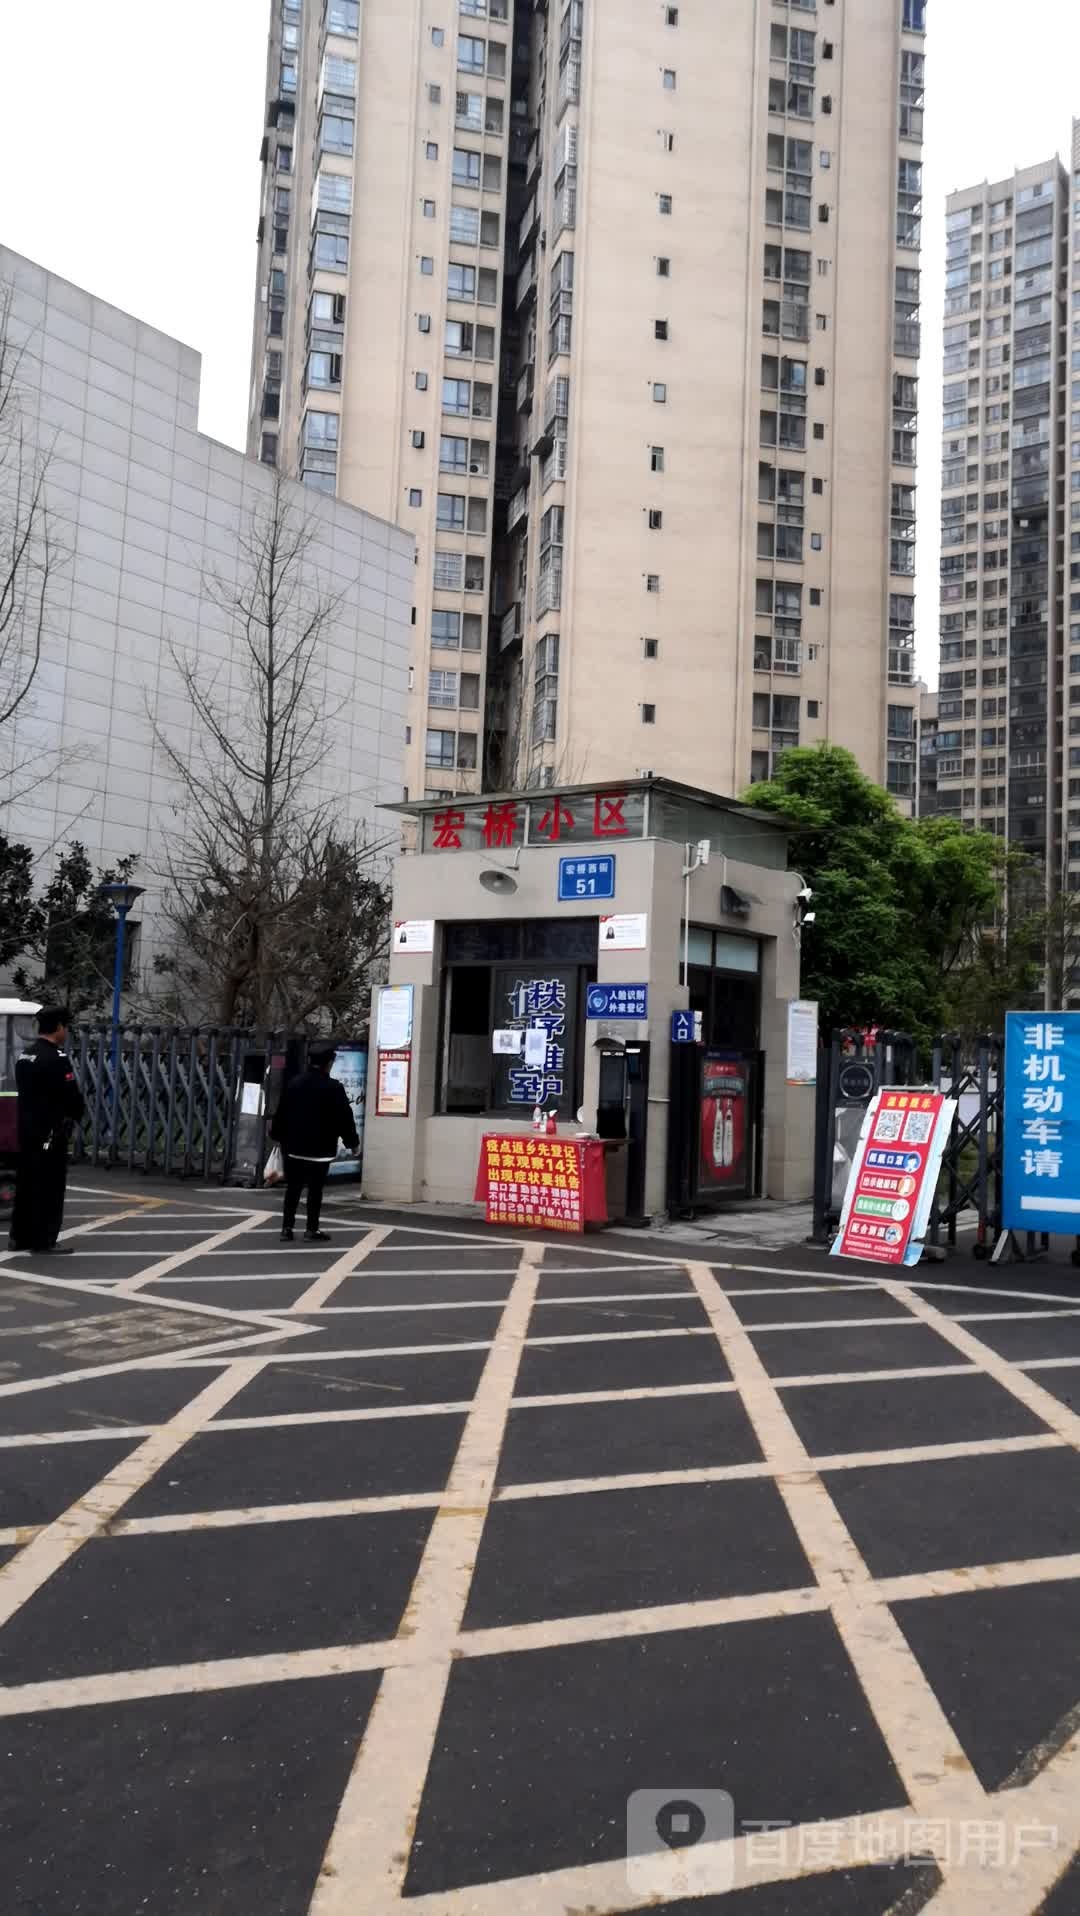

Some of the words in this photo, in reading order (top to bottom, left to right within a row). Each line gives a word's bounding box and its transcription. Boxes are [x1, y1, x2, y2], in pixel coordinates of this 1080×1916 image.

[432, 793, 630, 849] 宏桥小区
[565, 863, 609, 875] 宏桥西街
[576, 879, 596, 894] 51
[609, 990, 645, 1000] 人脸识别
[609, 1002, 645, 1013] 外来登记
[677, 1014, 689, 1039] 入口
[1020, 1023, 1066, 1178] 非机动车请
[486, 1140, 576, 1158] 疫点返乡先登记
[487, 1153, 578, 1175] 居家观察14天
[488, 1168, 580, 1189] 出现症状要报告
[520, 1194, 549, 1206] 不串门
[489, 1202, 534, 1213] 对自己负责
[538, 1206, 580, 1220] 对他人负责
